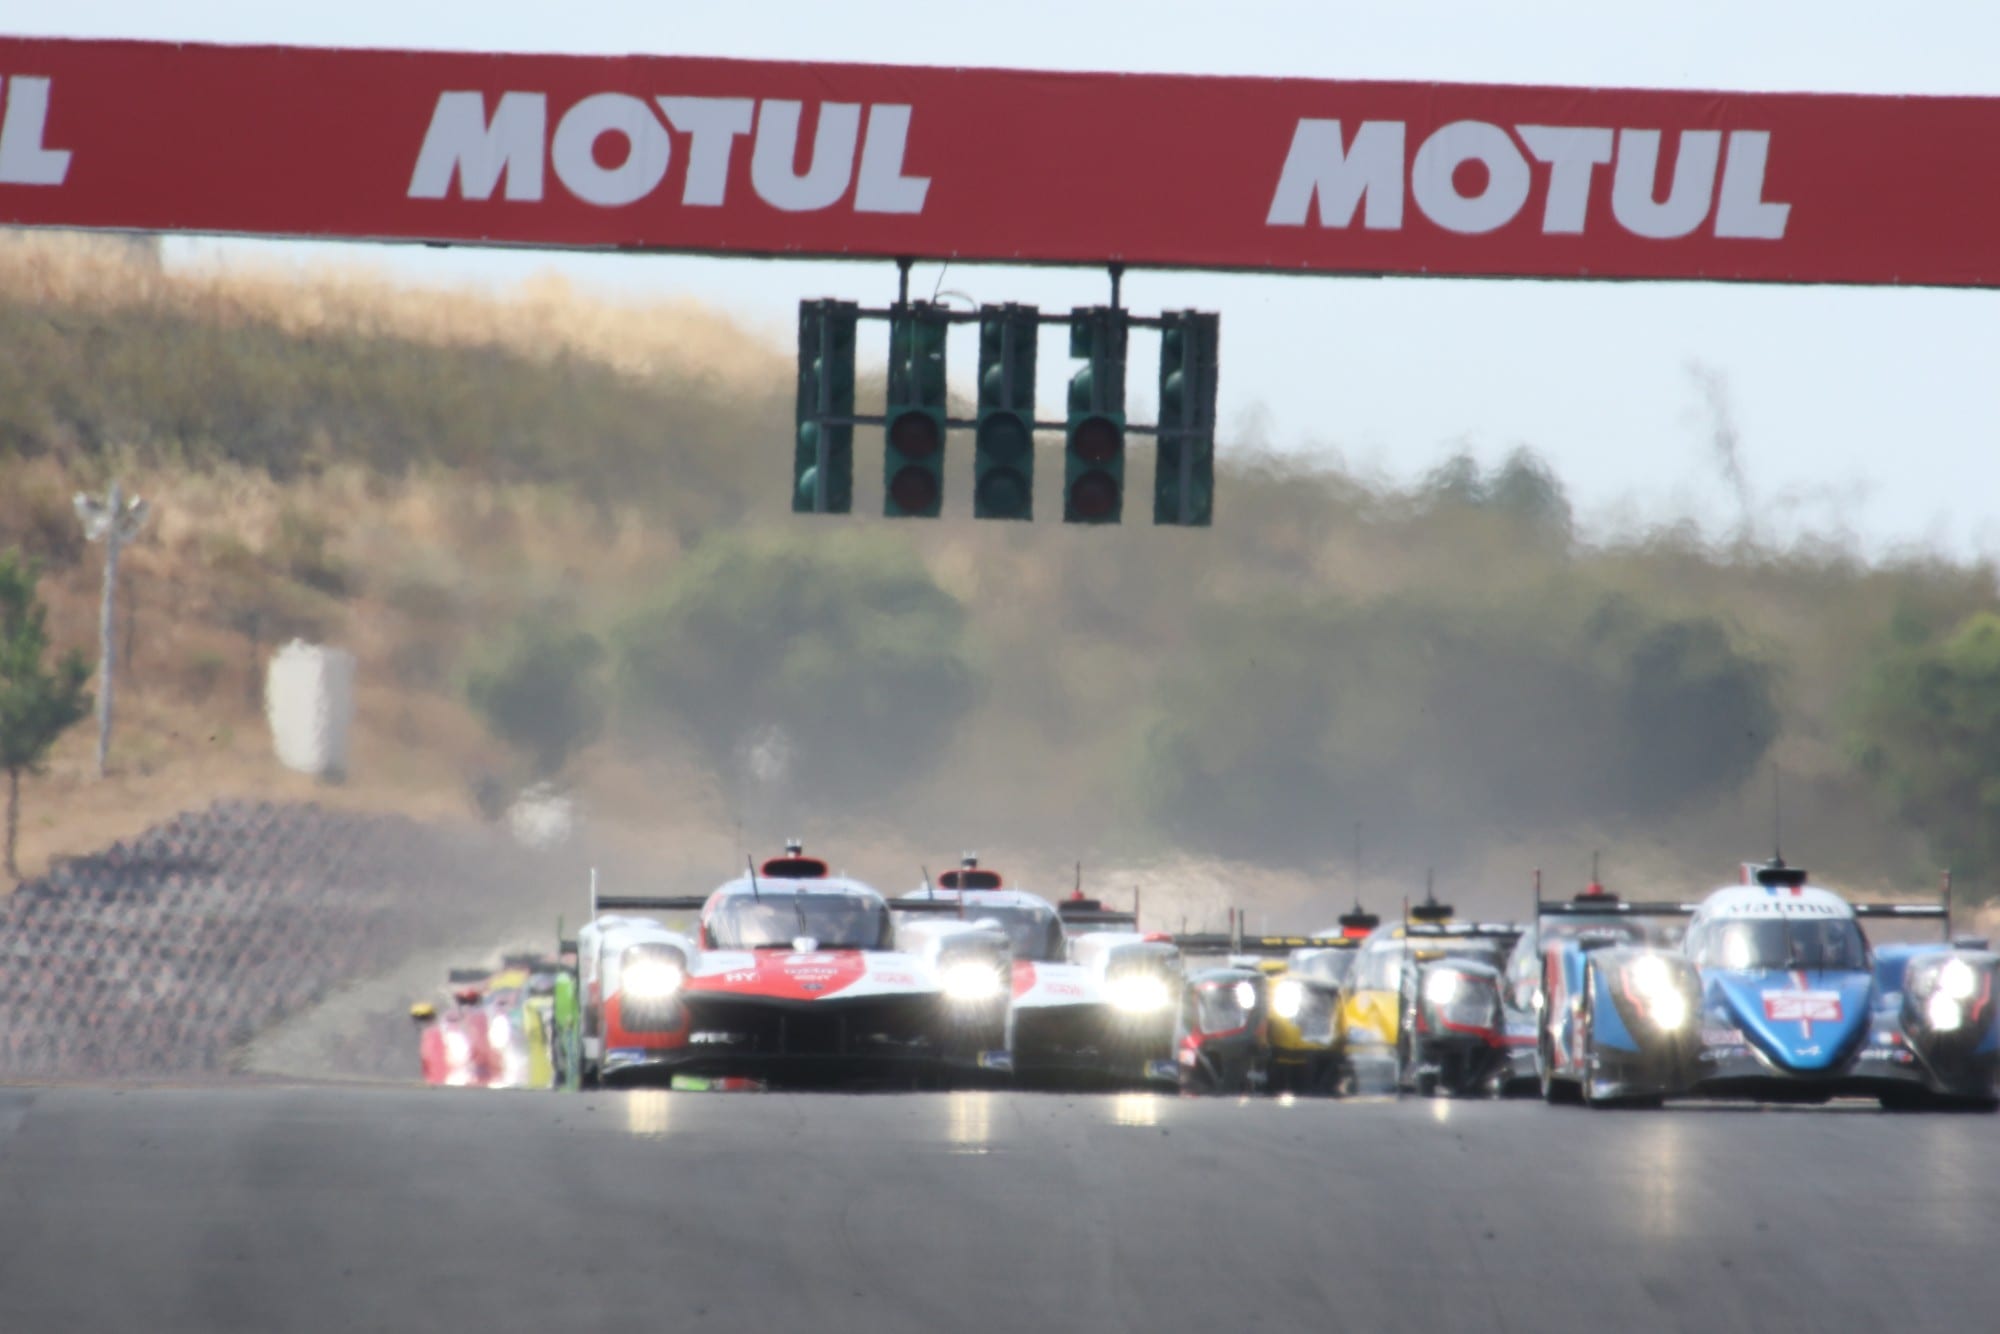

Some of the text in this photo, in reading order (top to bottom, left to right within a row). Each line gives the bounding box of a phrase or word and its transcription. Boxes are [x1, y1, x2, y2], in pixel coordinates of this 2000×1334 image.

[0, 76, 72, 185] L
[407, 91, 932, 213] MOTUL
[1265, 118, 1792, 239] MOTUL
